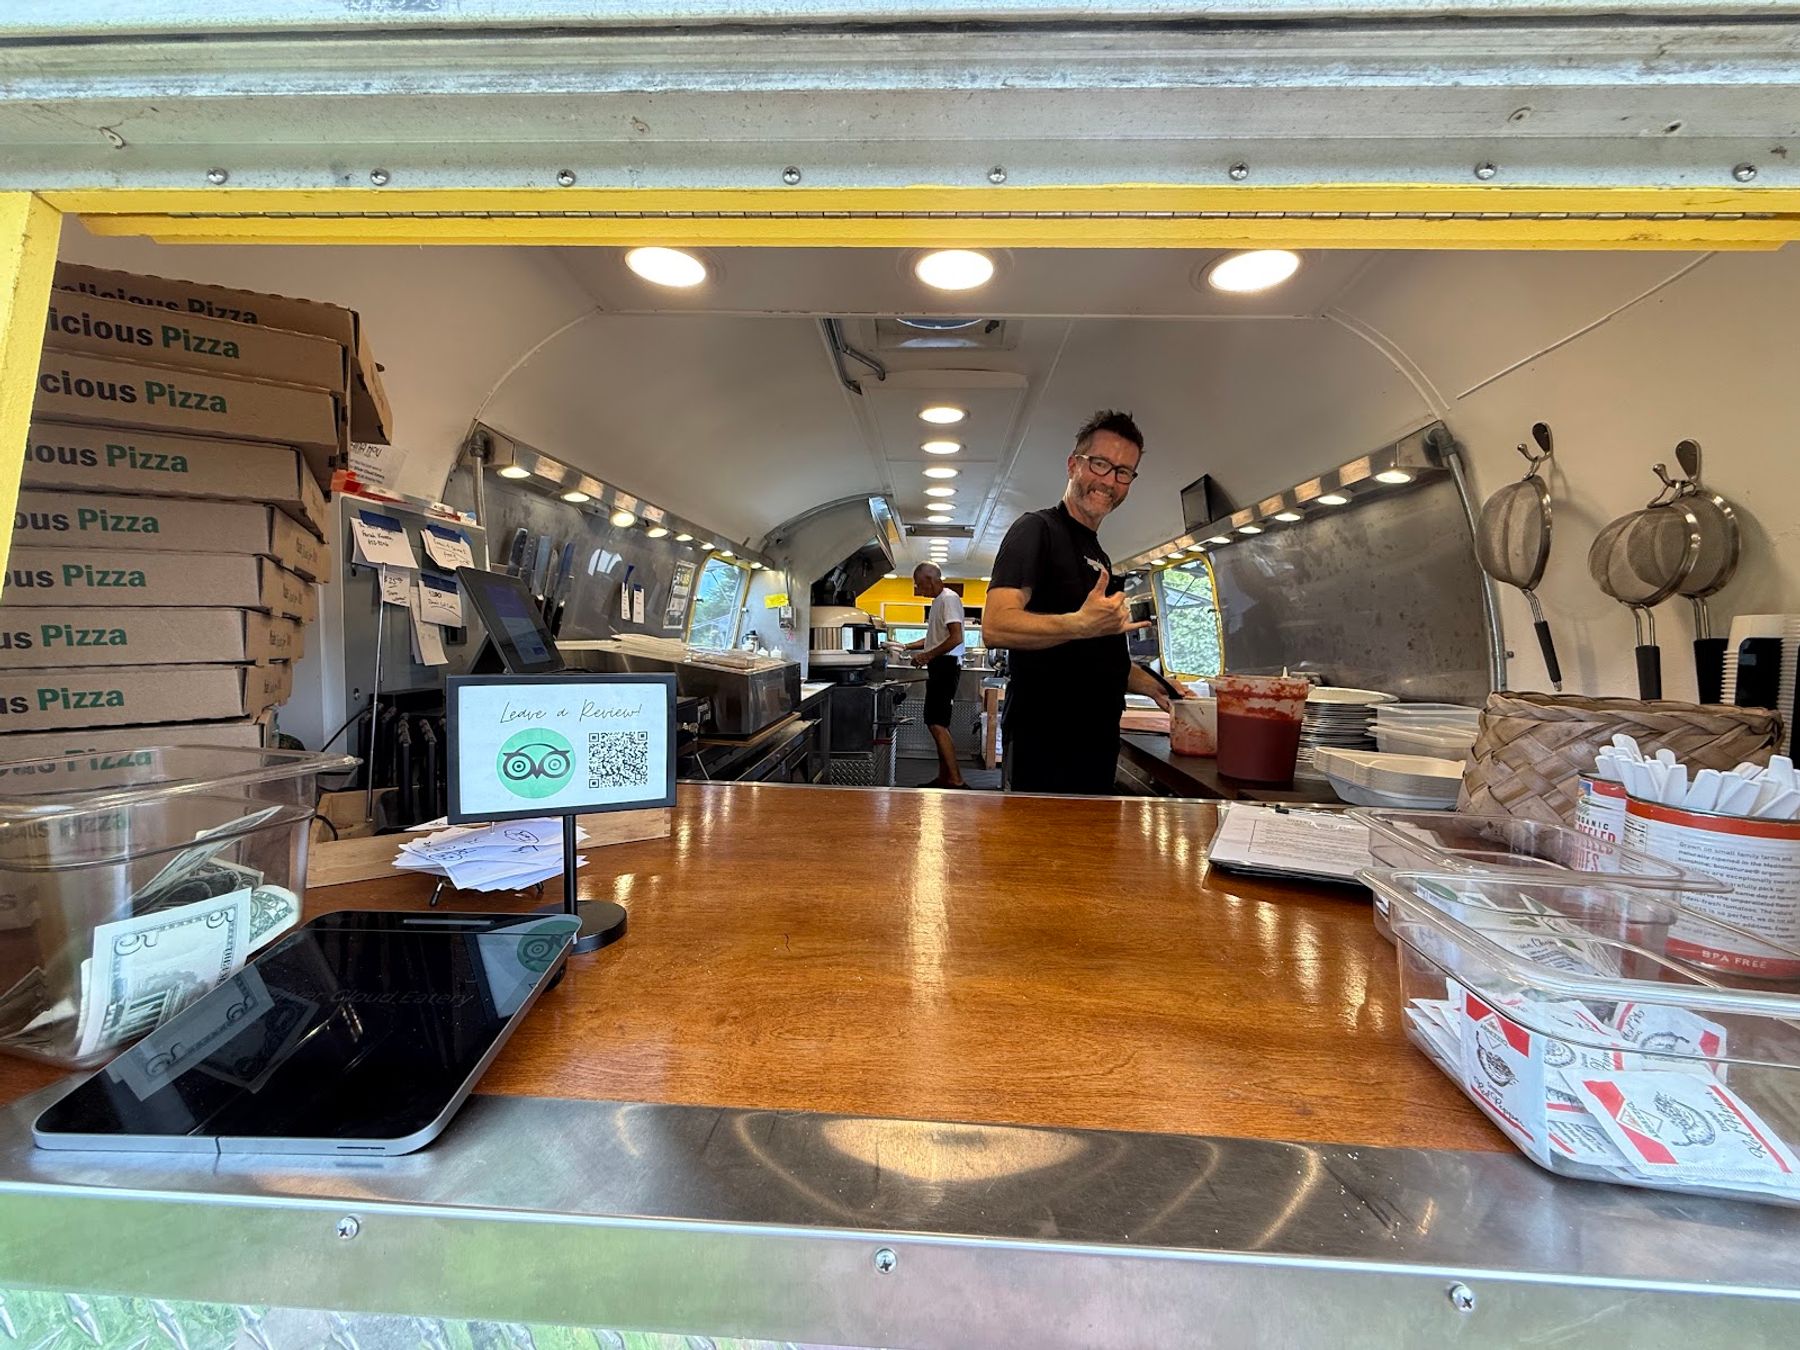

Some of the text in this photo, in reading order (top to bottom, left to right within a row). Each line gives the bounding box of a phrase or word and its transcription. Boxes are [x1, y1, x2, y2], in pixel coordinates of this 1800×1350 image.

[187, 298, 258, 324] Pizza
[161, 325, 240, 359] Pizza
[40, 370, 228, 414] cious Pizza
[106, 444, 188, 473] Pizza
[78, 508, 160, 533] Pizza
[62, 564, 146, 587] Pizza
[41, 624, 128, 647] Pizza
[37, 688, 125, 711] Pizza
[500, 698, 642, 724] Leave a Review!
[1714, 848, 1735, 856] small
[1737, 850, 1760, 860] family
[1702, 949, 1768, 969] BPA FREE
